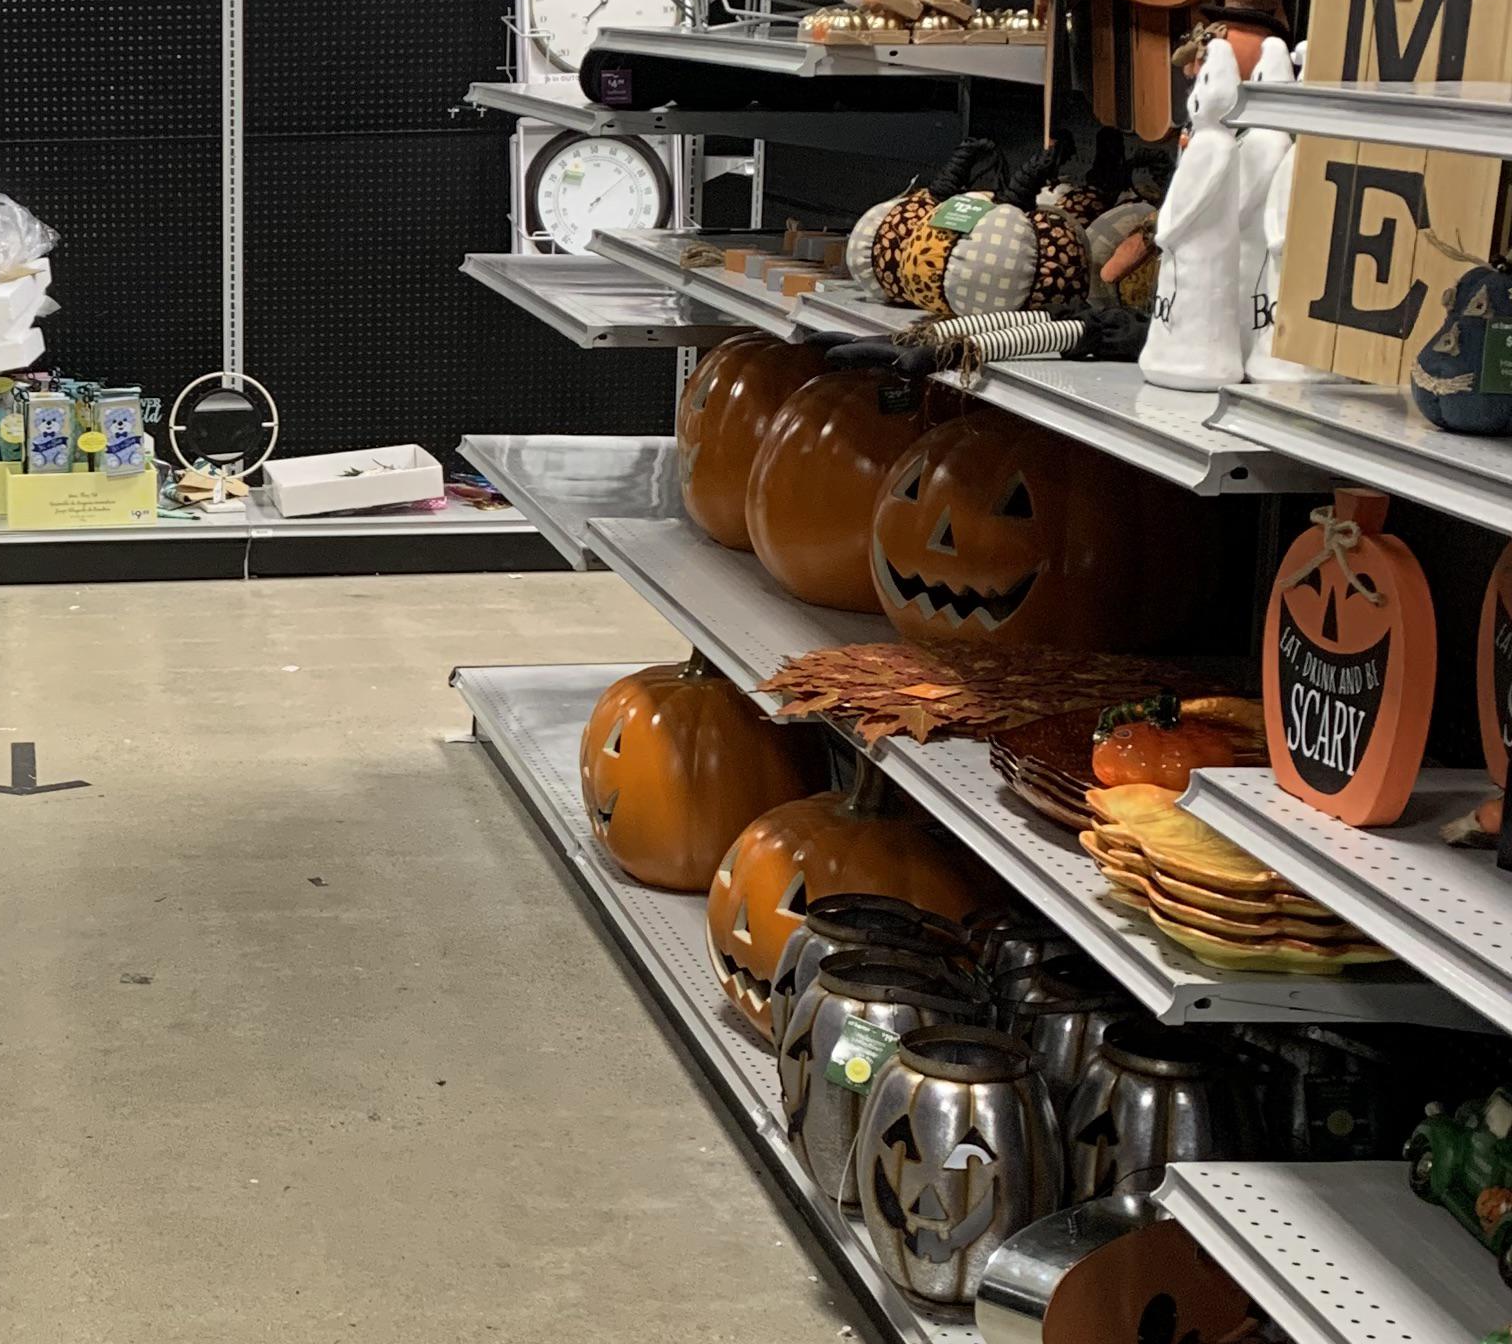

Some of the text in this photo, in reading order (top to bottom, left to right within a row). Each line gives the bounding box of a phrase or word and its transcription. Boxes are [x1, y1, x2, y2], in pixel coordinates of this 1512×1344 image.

[1302, 651, 1336, 693] DRINK
[1338, 666, 1363, 695] AND
[1365, 659, 1380, 690] BE
[1287, 682, 1366, 776] SCARY
